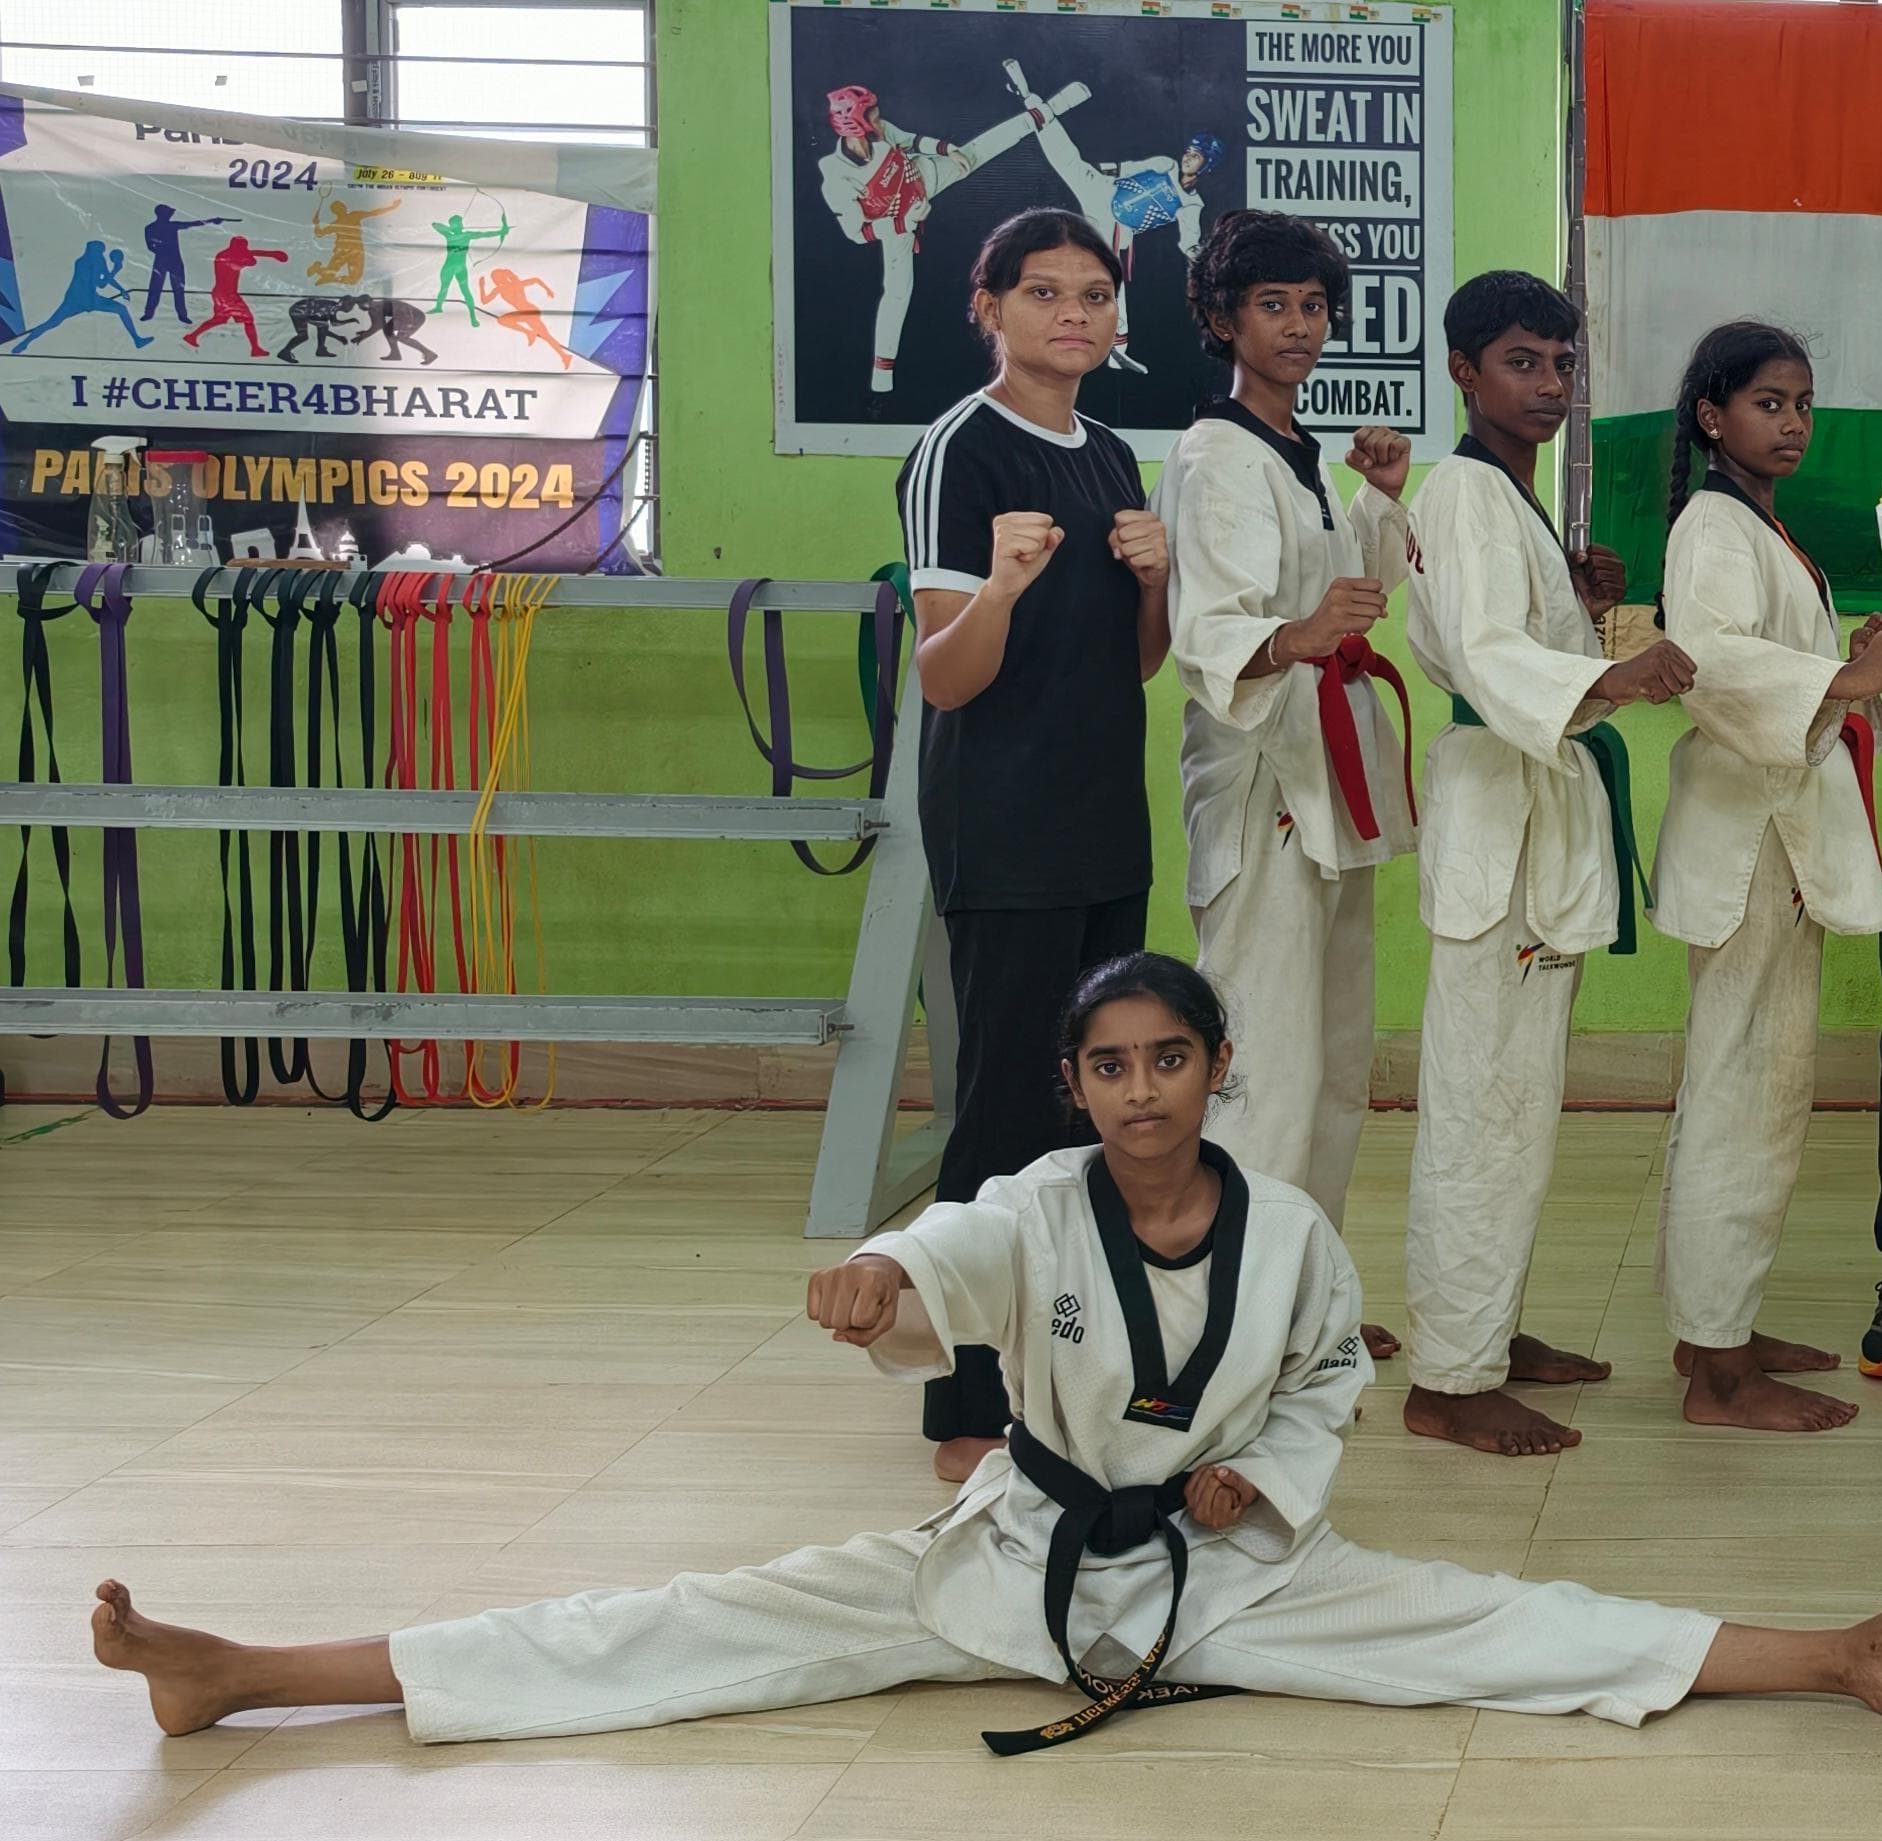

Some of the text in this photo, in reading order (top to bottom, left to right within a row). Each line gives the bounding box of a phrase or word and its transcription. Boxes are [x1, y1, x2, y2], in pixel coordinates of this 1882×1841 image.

[1255, 31, 1412, 65] THE MORE YOU
[1246, 88, 1420, 145] SWEAT IN
[228, 158, 318, 191] 2024
[381, 169, 395, 179] 26
[1255, 157, 1413, 208] TRAINING,
[1315, 222, 1420, 260] SS YOU
[72, 375, 538, 421] I #CHEER4BHARAT
[1293, 378, 1413, 417] COMBAT.
[191, 454, 429, 507] OLYMPICS
[445, 463, 575, 509] 2024
